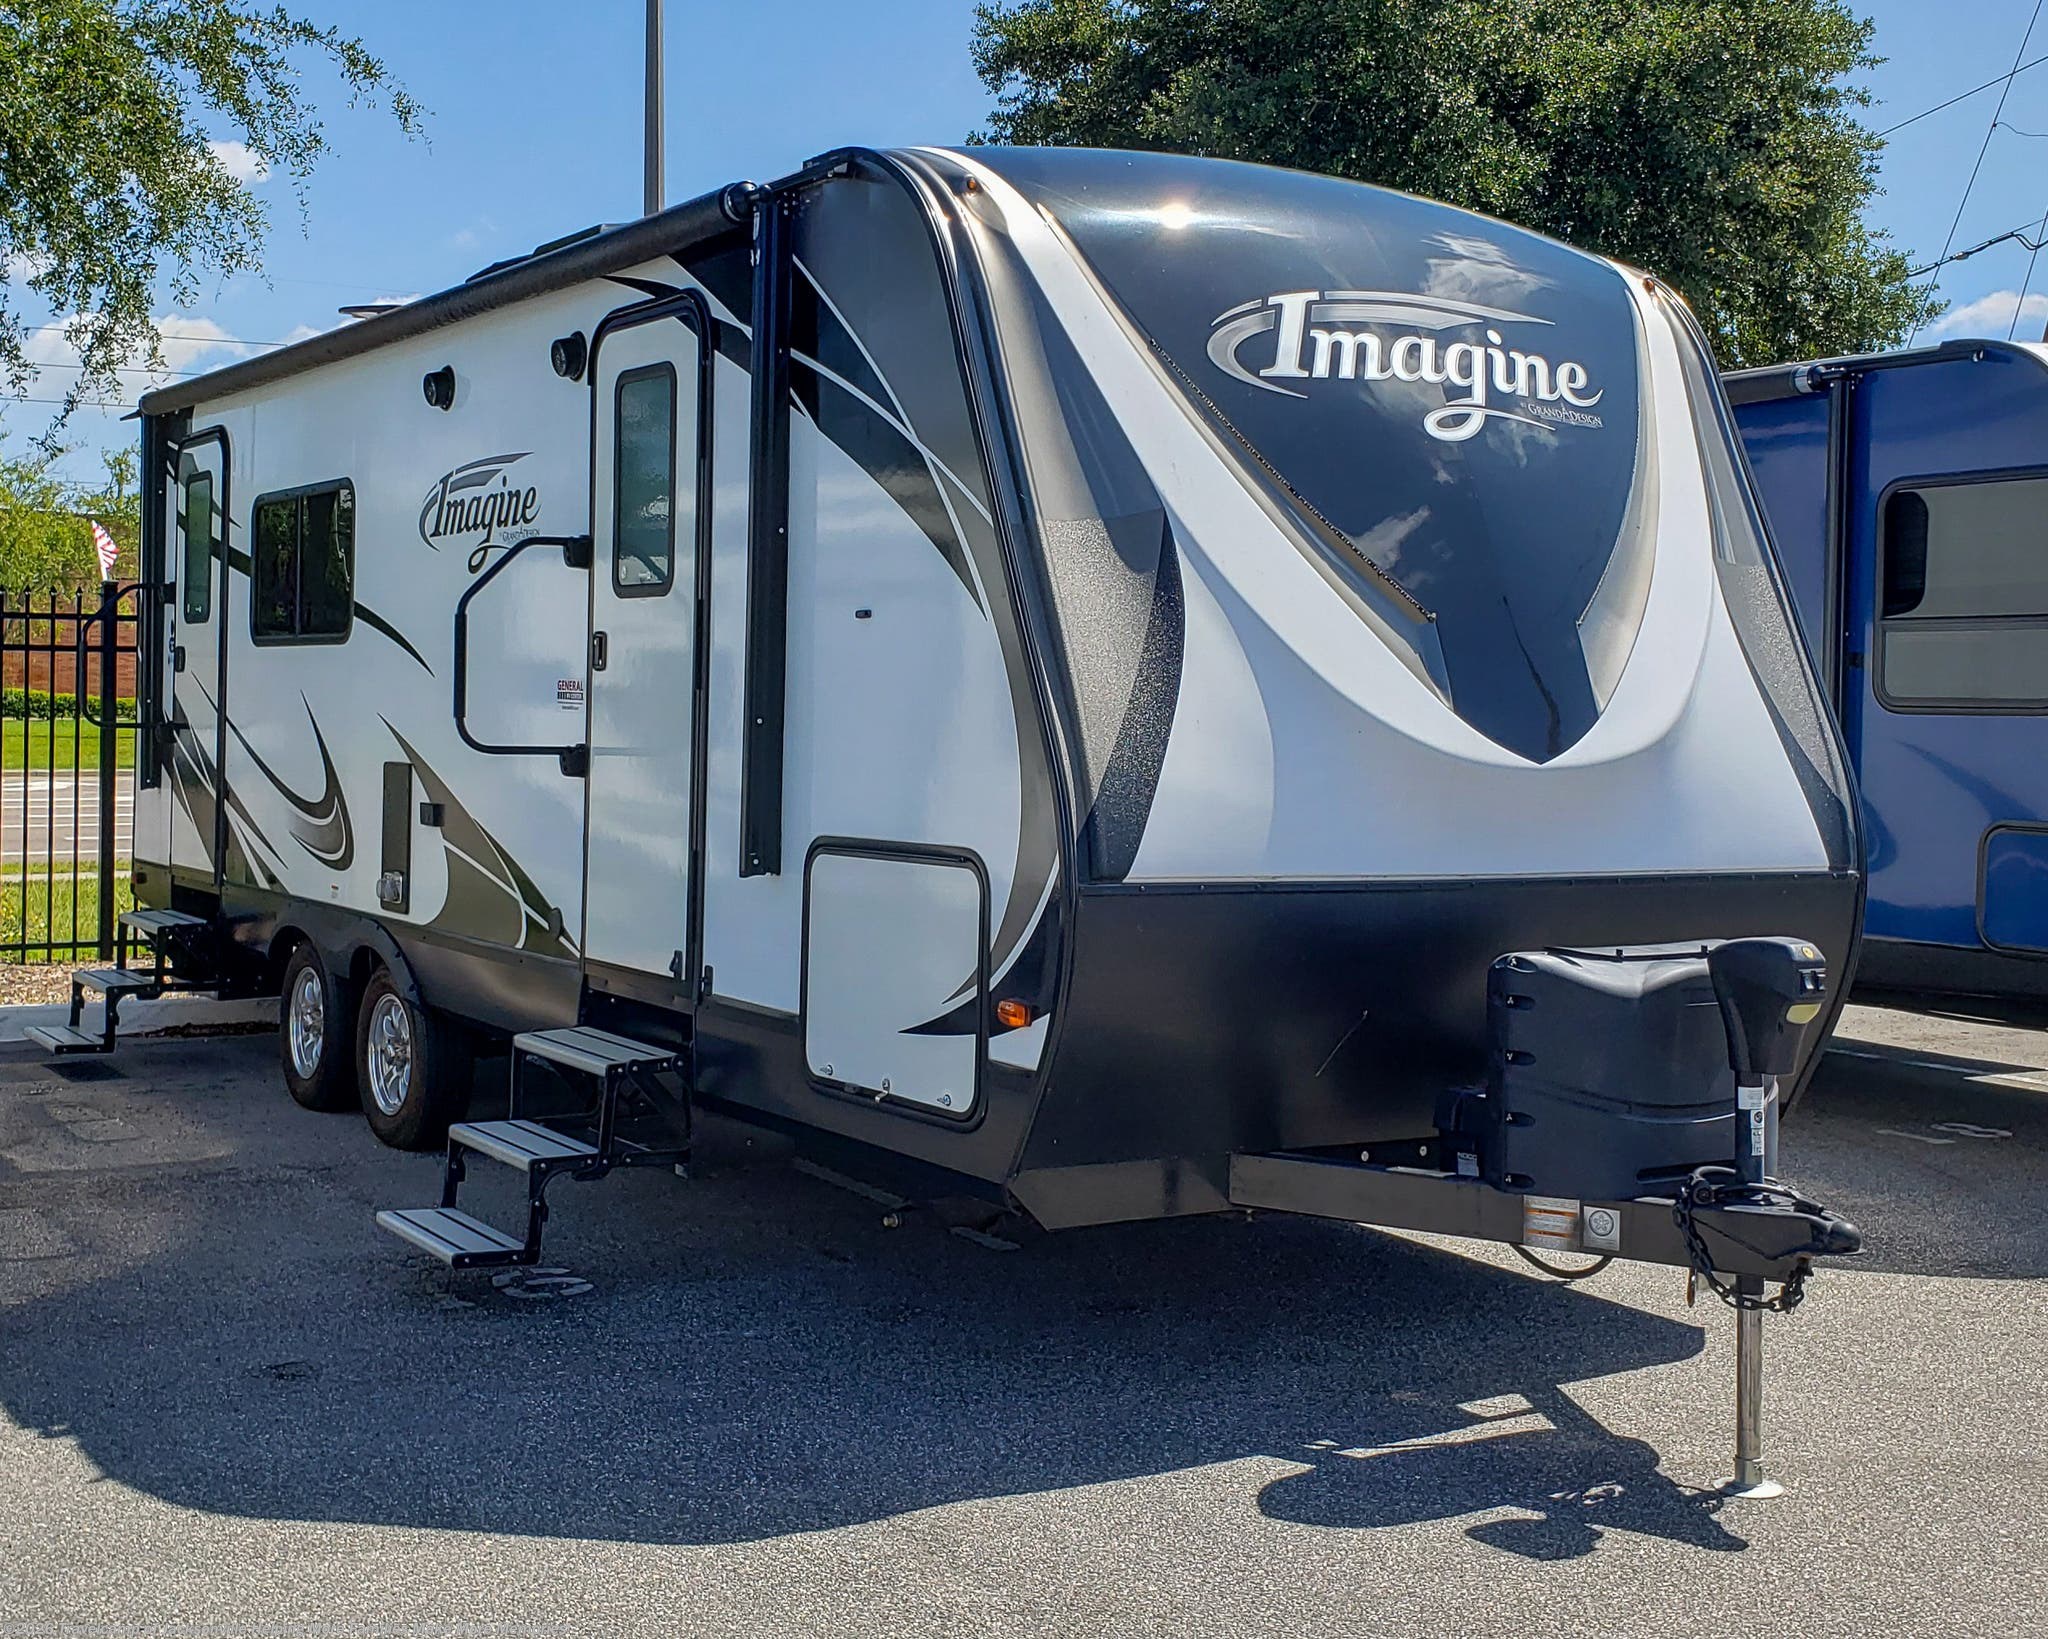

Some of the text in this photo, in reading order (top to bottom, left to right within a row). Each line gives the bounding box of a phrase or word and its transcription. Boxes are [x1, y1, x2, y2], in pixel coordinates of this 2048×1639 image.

[1259, 291, 1602, 441] Imagine
[429, 470, 541, 574] Imagine
[557, 680, 583, 691] GENERAL
